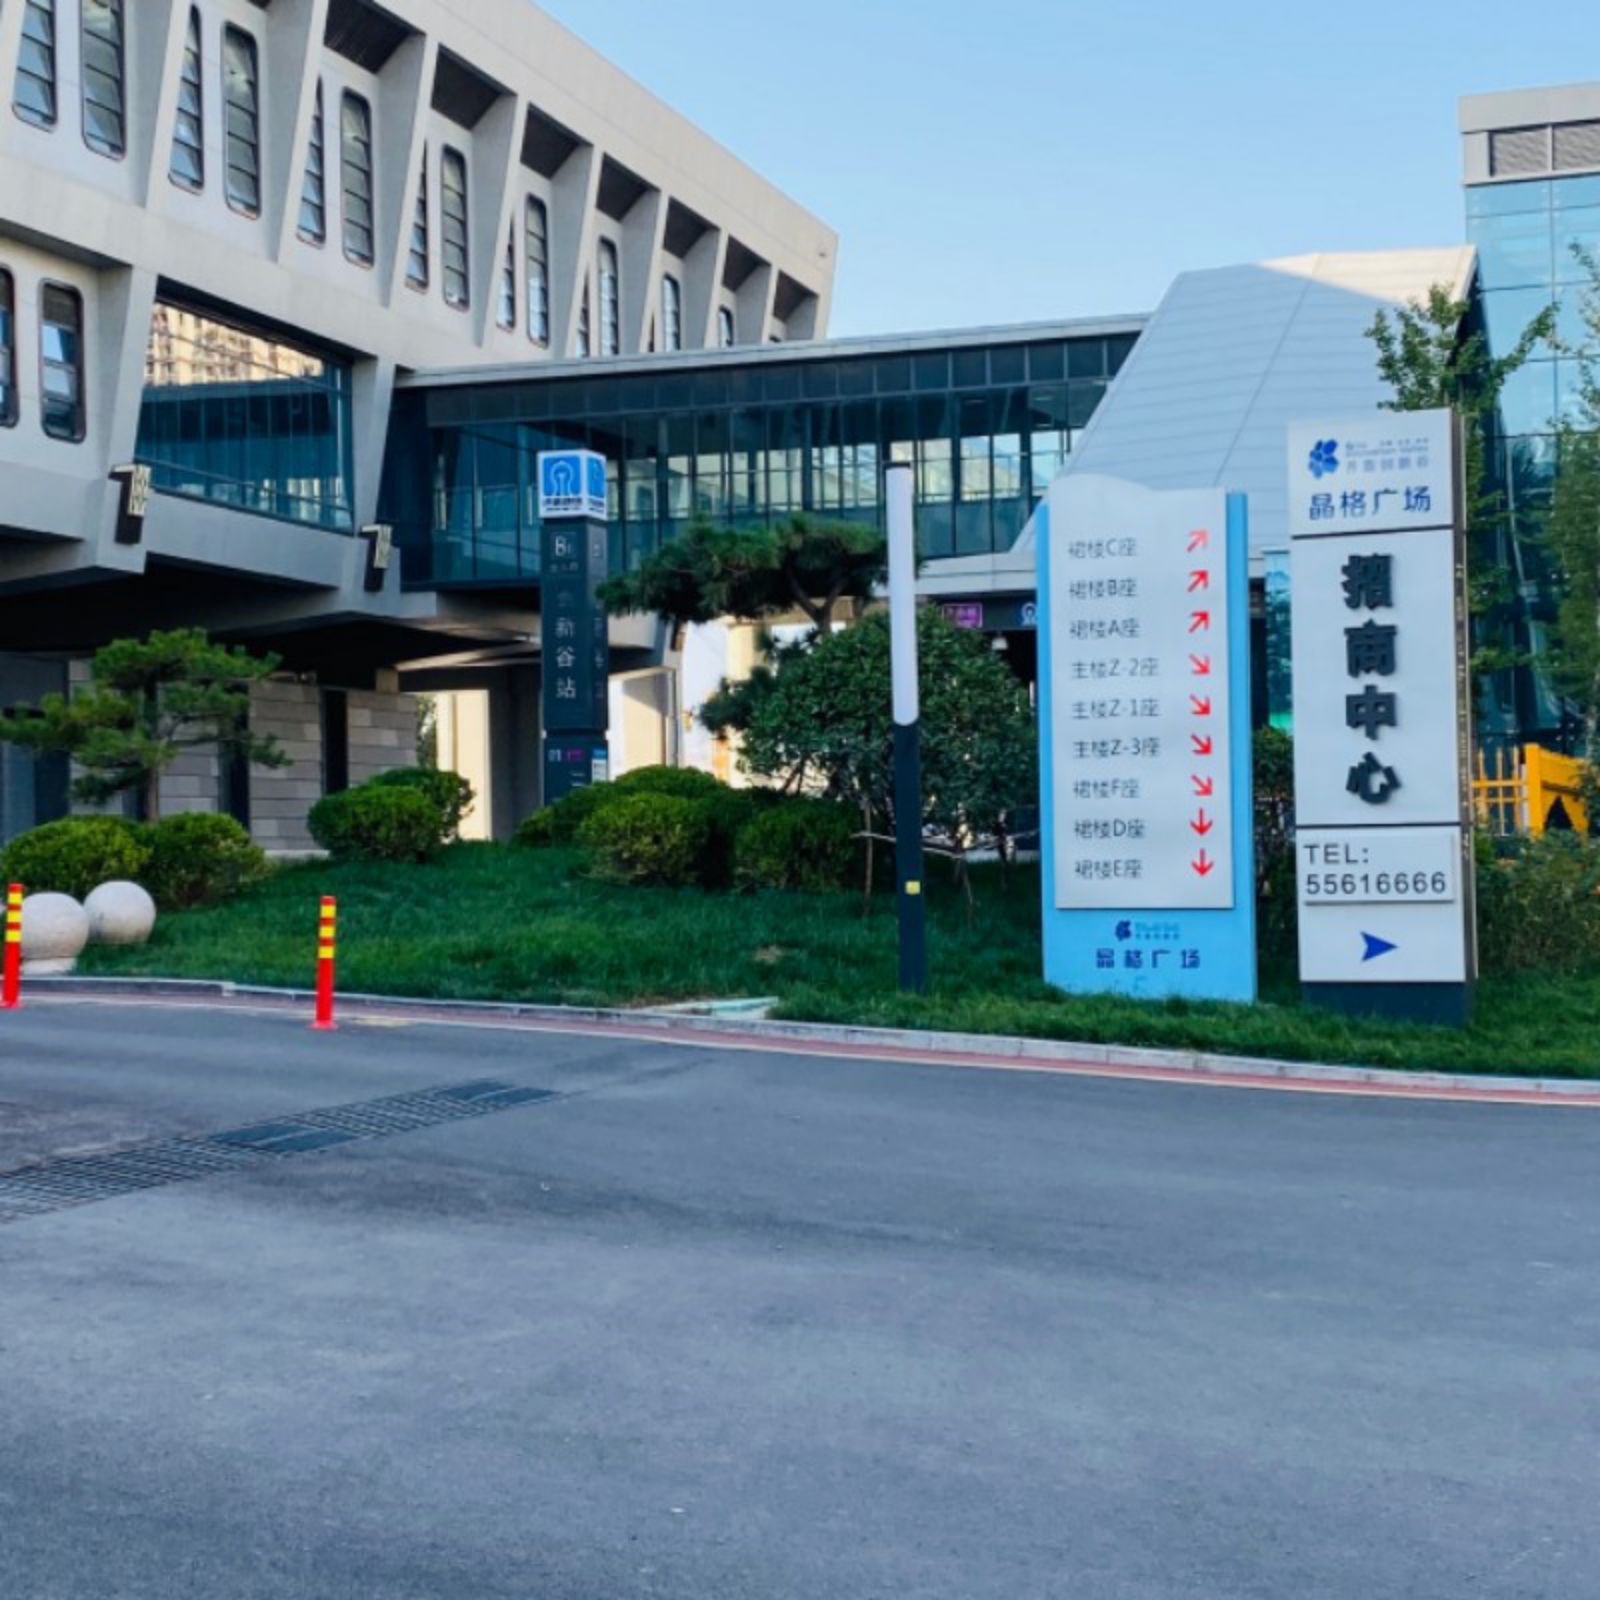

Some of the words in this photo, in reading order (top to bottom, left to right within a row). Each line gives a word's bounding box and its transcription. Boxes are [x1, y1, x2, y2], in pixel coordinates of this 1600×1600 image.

[1309, 485, 1432, 520] 晶格广场
[1069, 538, 1137, 558] 裙楼C座
[1069, 578, 1137, 598] 裙楼B座
[1070, 618, 1140, 639] 裙楼A座
[1341, 553, 1402, 805] 招商中心
[1073, 779, 1141, 800] 裙楼F座
[1074, 819, 1145, 840] 裙楼D座
[1303, 844, 1369, 864] TEL:
[1075, 859, 1142, 880] 裙楼E座
[1306, 872, 1446, 895] 55616666
[1096, 949, 1200, 969] 晶格广场
